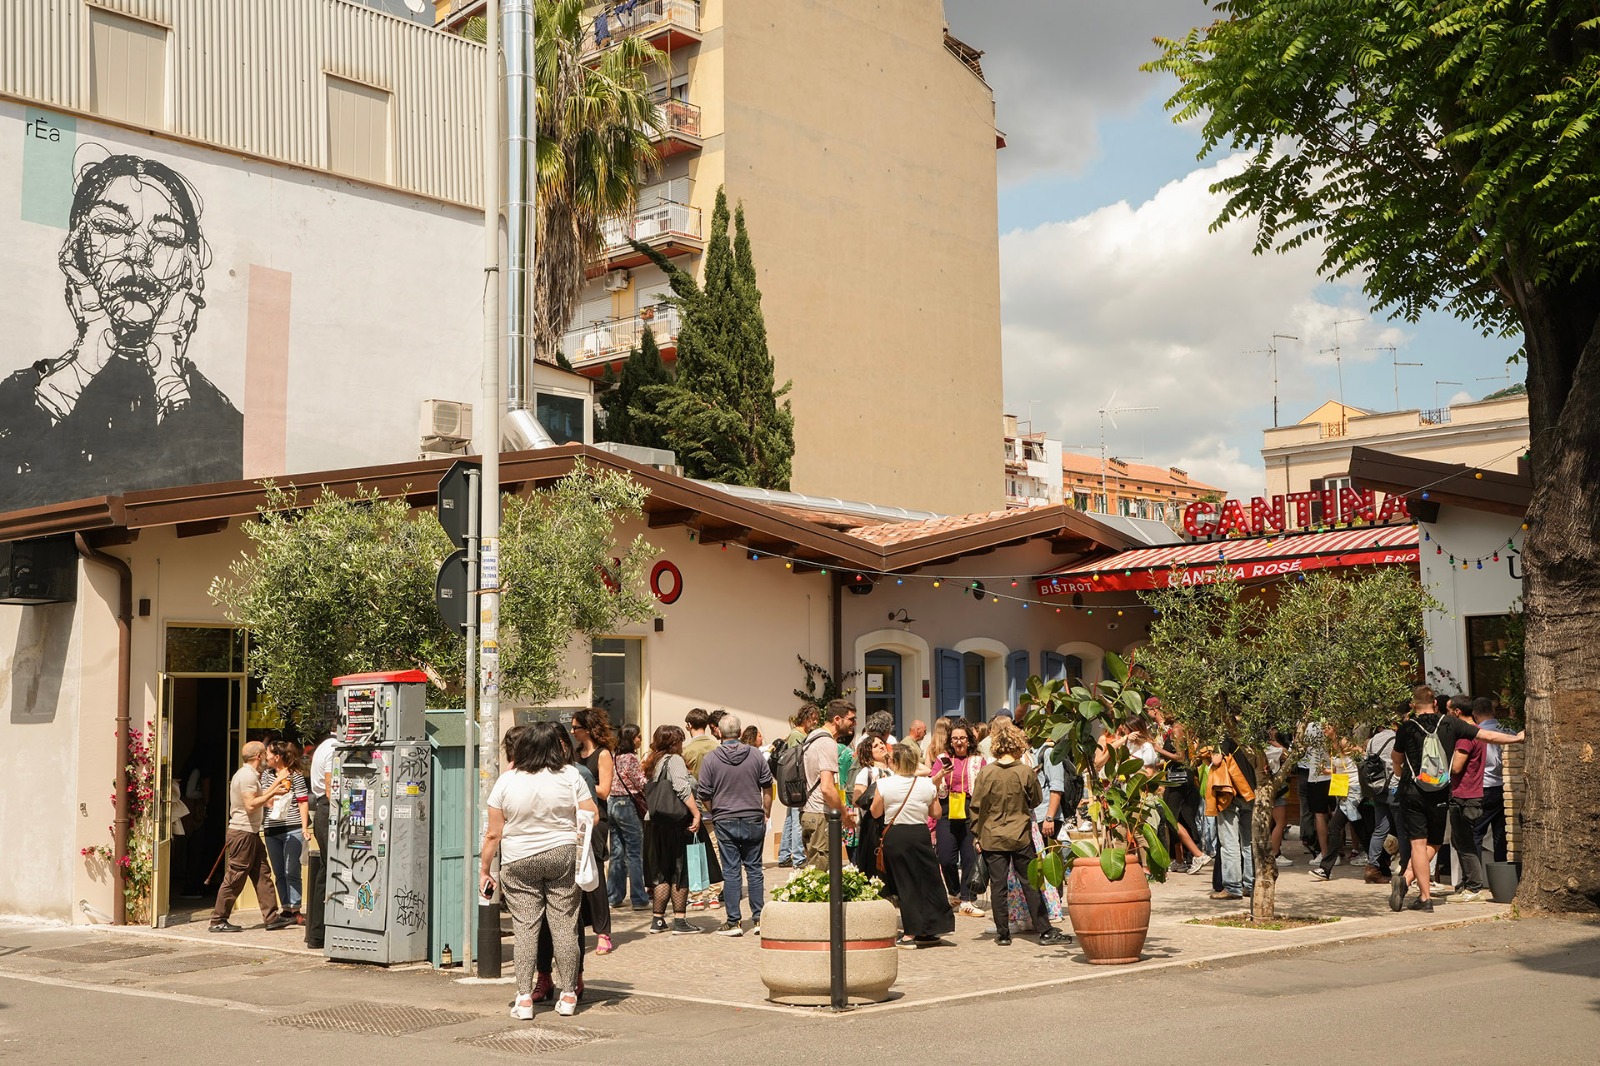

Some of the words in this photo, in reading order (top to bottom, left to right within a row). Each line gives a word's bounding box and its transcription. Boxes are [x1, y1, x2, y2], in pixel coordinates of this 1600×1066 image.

[1183, 487, 1411, 537] CANTINA
[1168, 566, 1245, 588] CANTNA
[1251, 559, 1302, 577] ROSÉ
[1041, 582, 1092, 595] BISTROT
